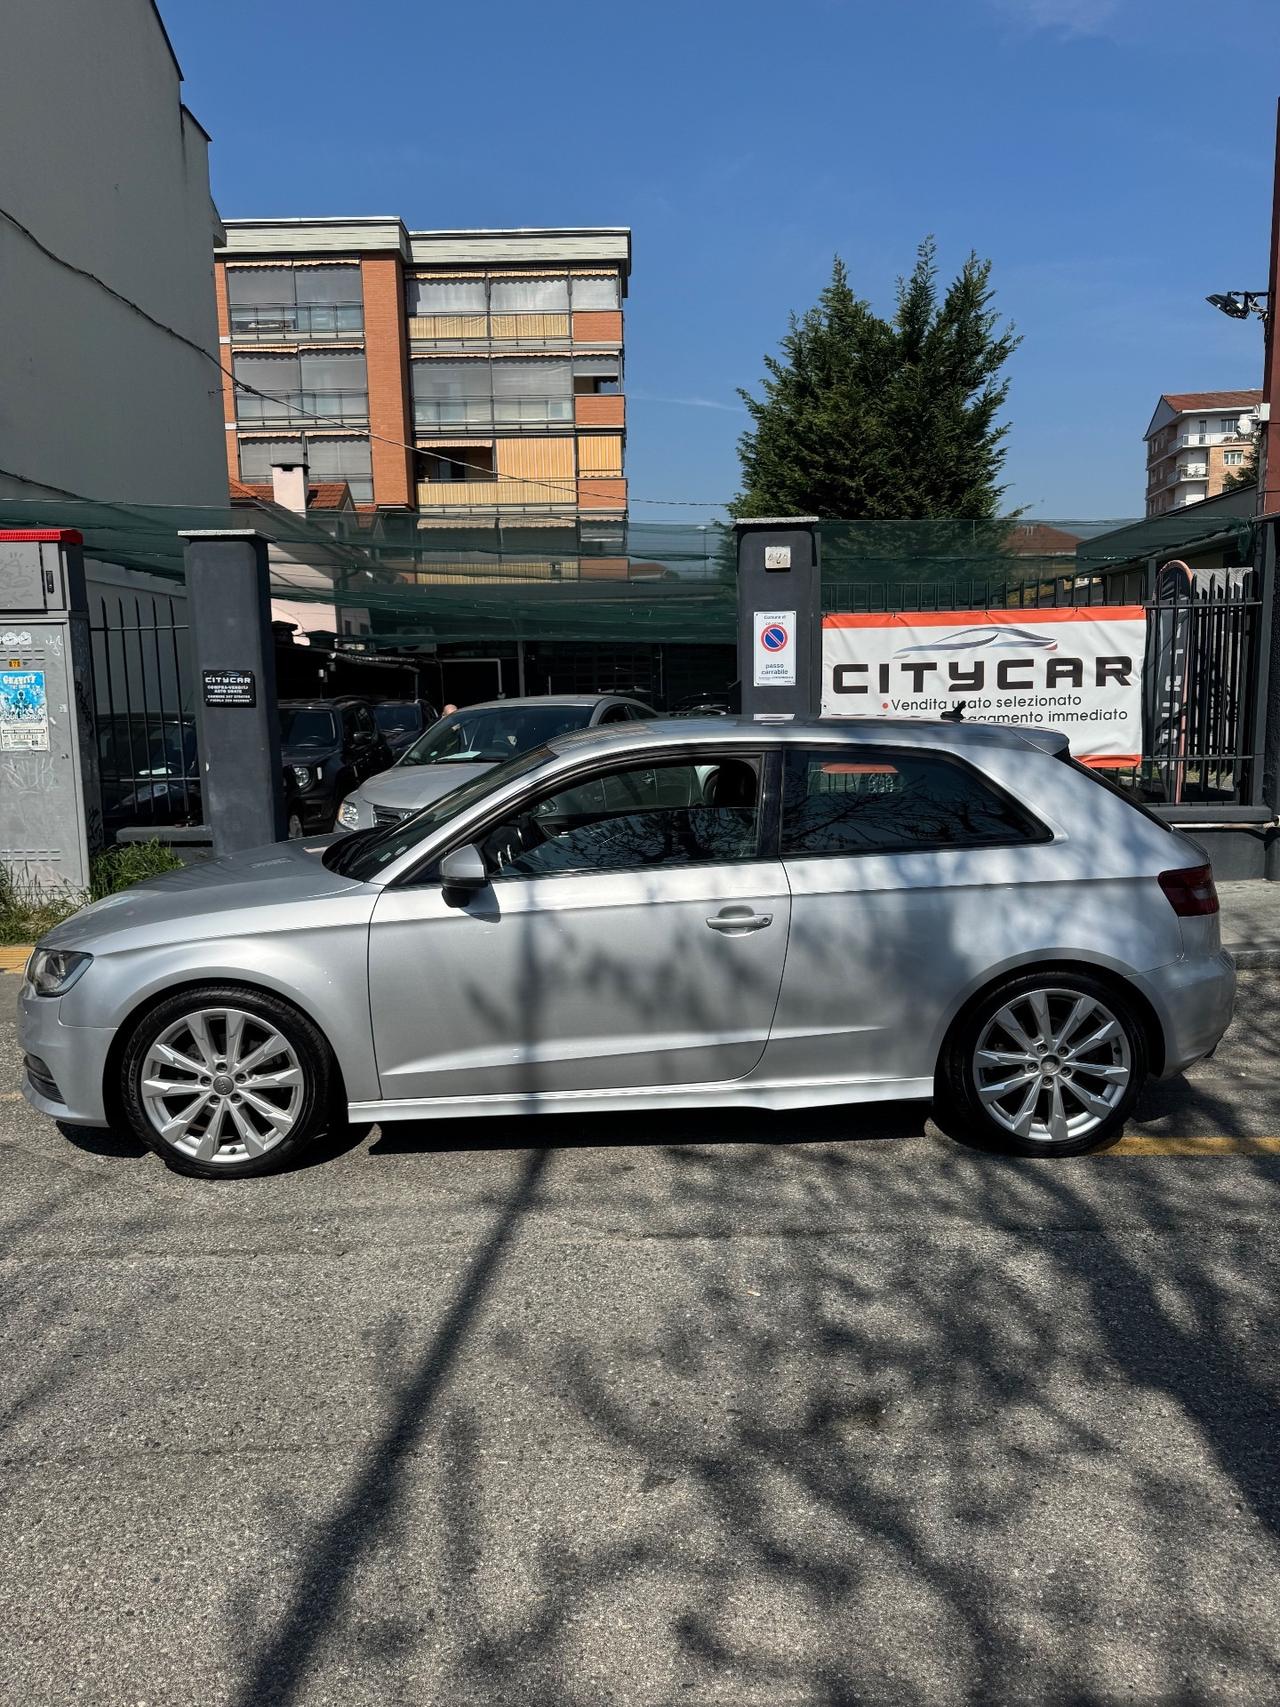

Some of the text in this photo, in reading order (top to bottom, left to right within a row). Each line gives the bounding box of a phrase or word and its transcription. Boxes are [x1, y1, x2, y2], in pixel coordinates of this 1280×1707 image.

[832, 655, 1133, 694] CITYCAR
[891, 694, 1082, 711] Vendita uato selezionato
[1048, 709, 1128, 722] immediato
